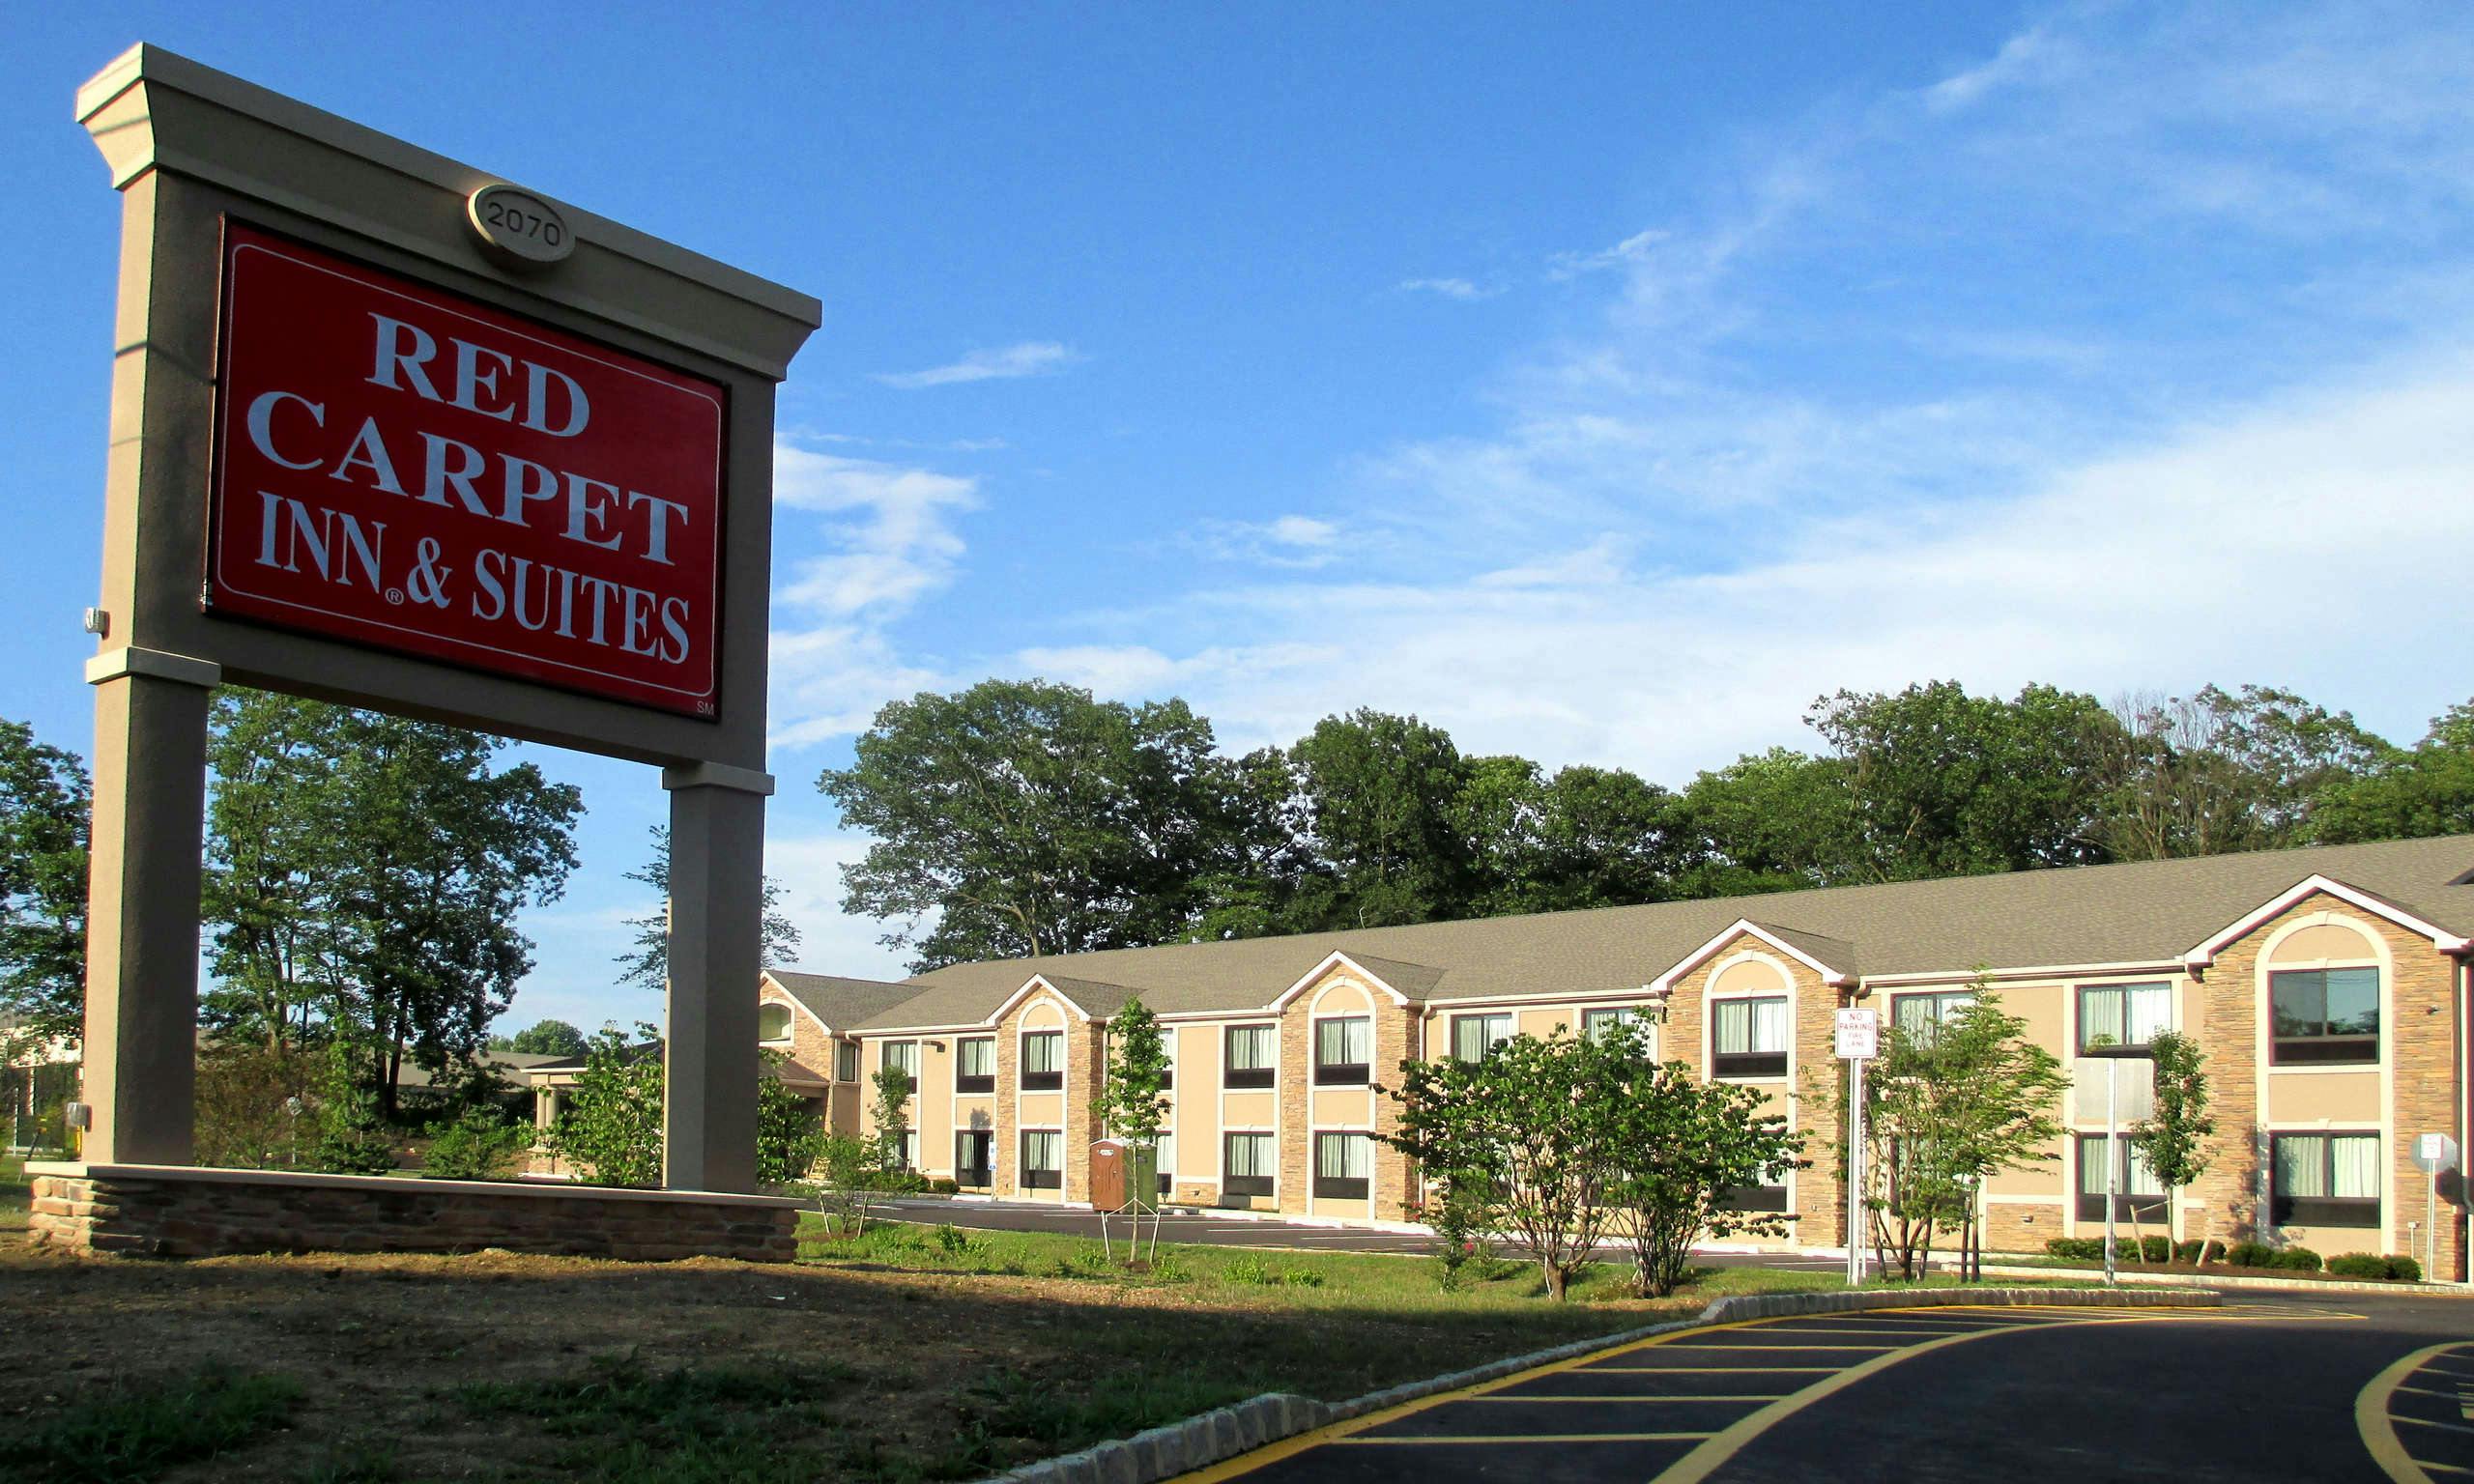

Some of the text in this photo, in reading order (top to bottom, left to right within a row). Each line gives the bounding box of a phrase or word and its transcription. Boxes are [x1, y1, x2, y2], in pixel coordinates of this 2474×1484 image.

[487, 201, 561, 246] 2070
[364, 313, 590, 437] RED
[247, 391, 688, 565] CARPET
[255, 491, 387, 593] INN
[407, 537, 452, 609] &
[473, 549, 689, 665] SUITES
[697, 700, 714, 715] SM
[1839, 1022, 1873, 1032] PARKING
[1849, 1012, 1863, 1021] NO
